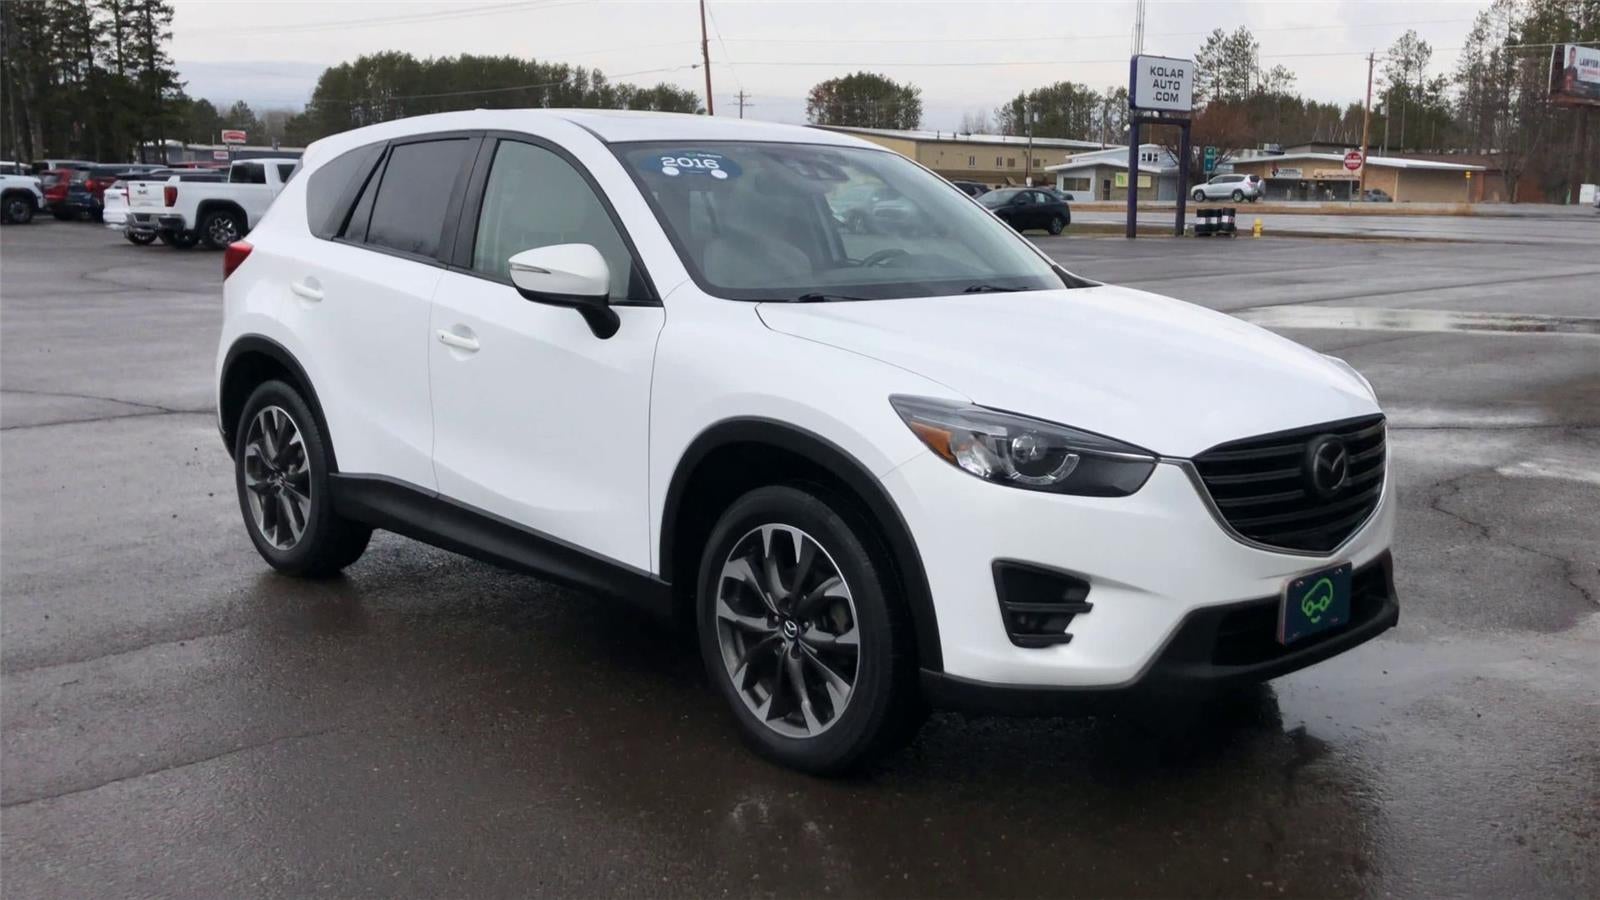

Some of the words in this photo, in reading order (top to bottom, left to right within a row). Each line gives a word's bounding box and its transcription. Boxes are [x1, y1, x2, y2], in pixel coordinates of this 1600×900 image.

[1150, 66, 1184, 78] KOLAR
[1153, 79, 1180, 91] AUTO
[1153, 92, 1179, 103] .COM
[660, 156, 720, 169] 2016
